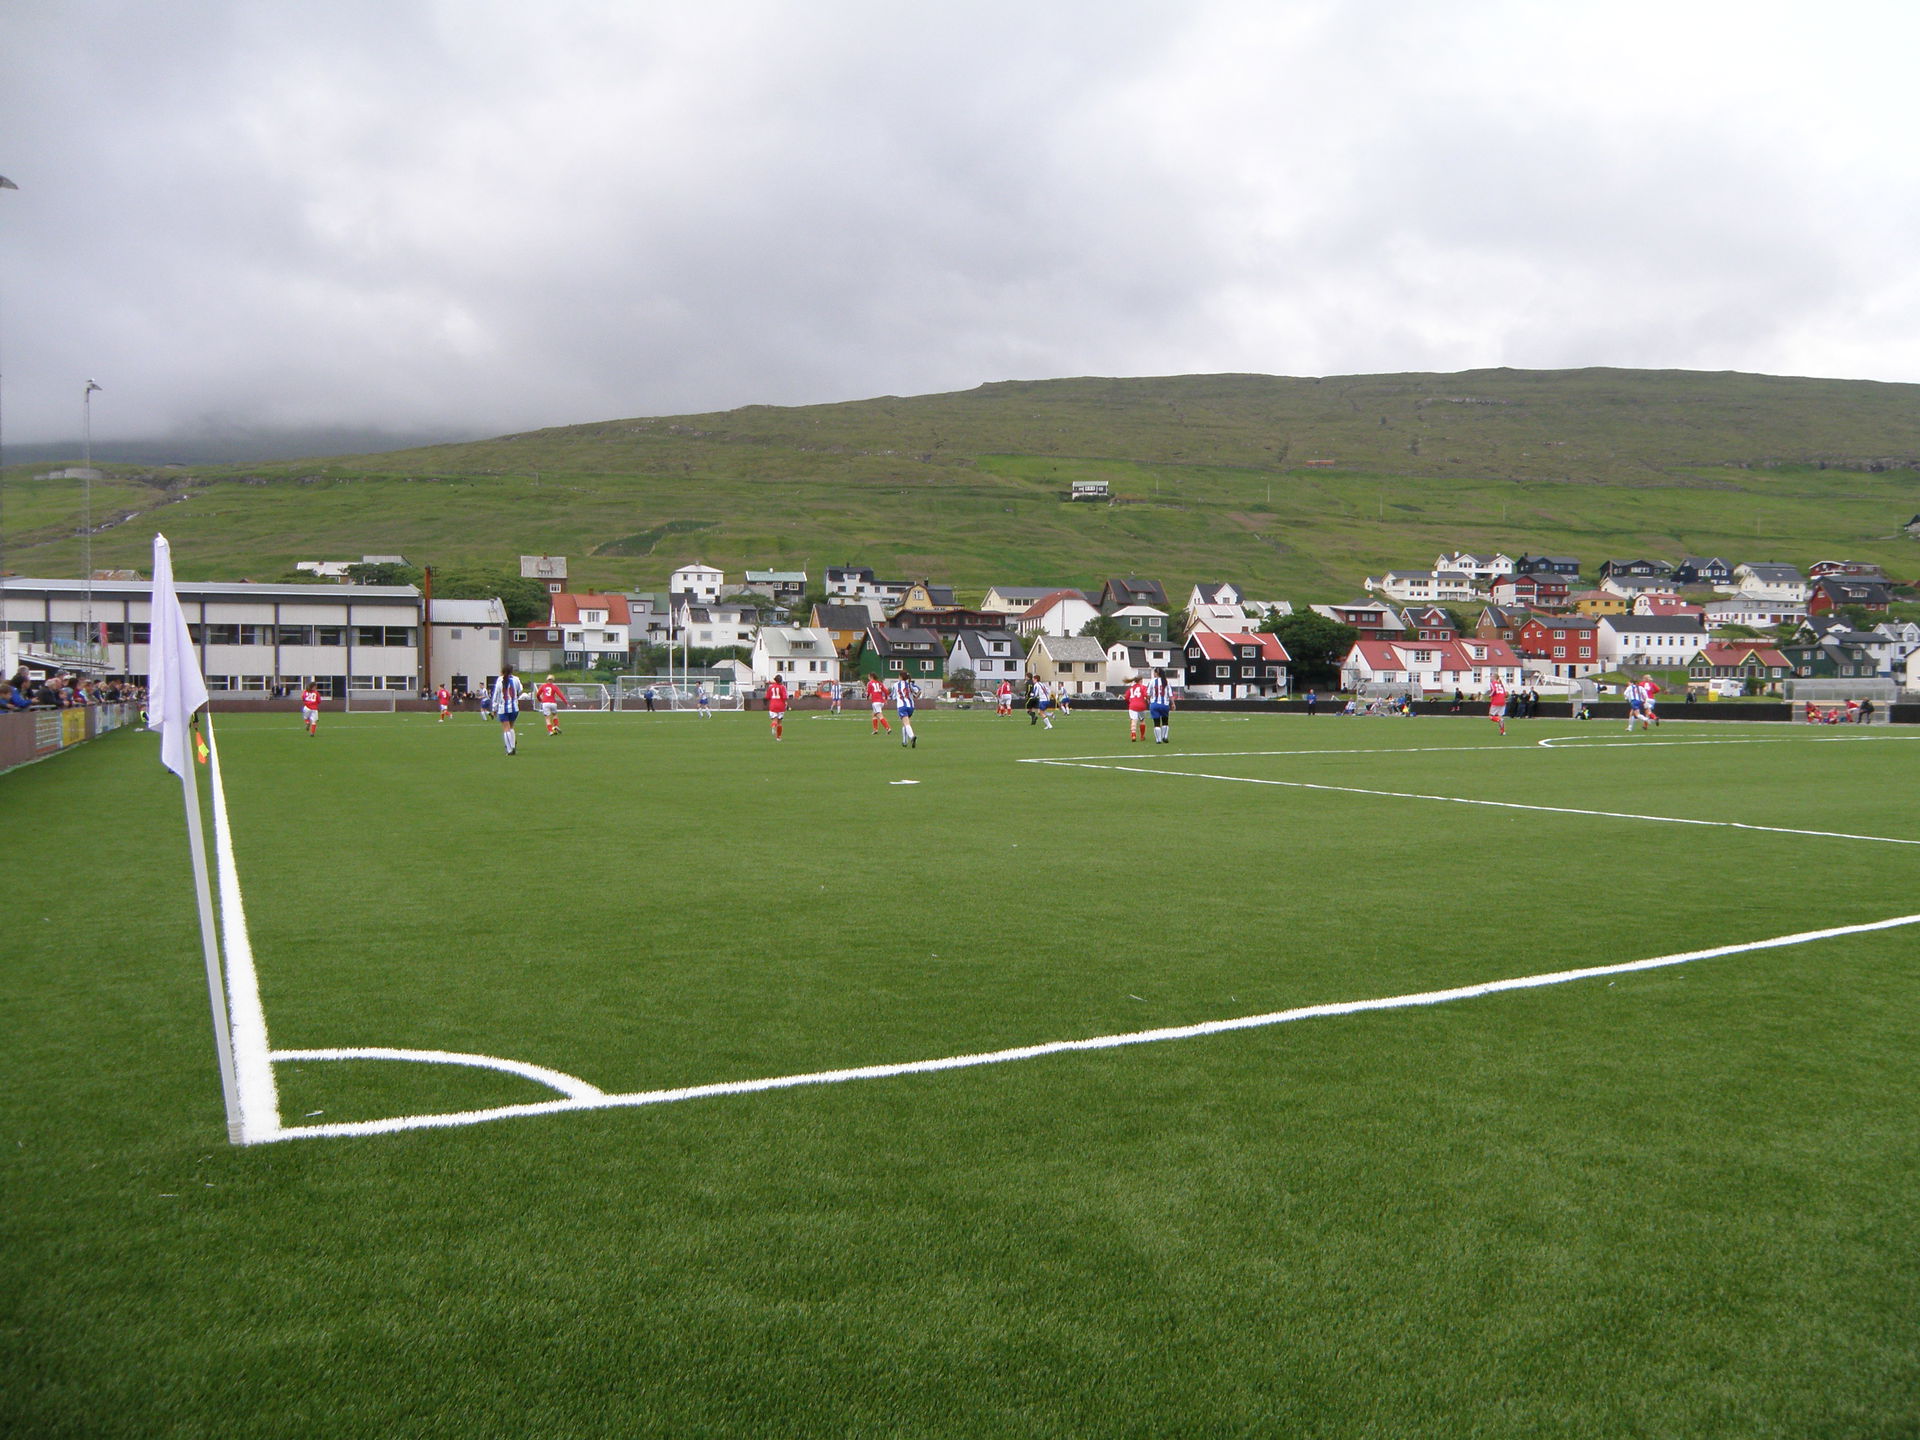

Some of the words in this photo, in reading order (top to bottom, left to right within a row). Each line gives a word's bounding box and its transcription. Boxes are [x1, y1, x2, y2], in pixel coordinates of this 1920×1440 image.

[545, 686, 552, 696] 3
[771, 687, 781, 699] 11
[1130, 686, 1141, 699] 14
